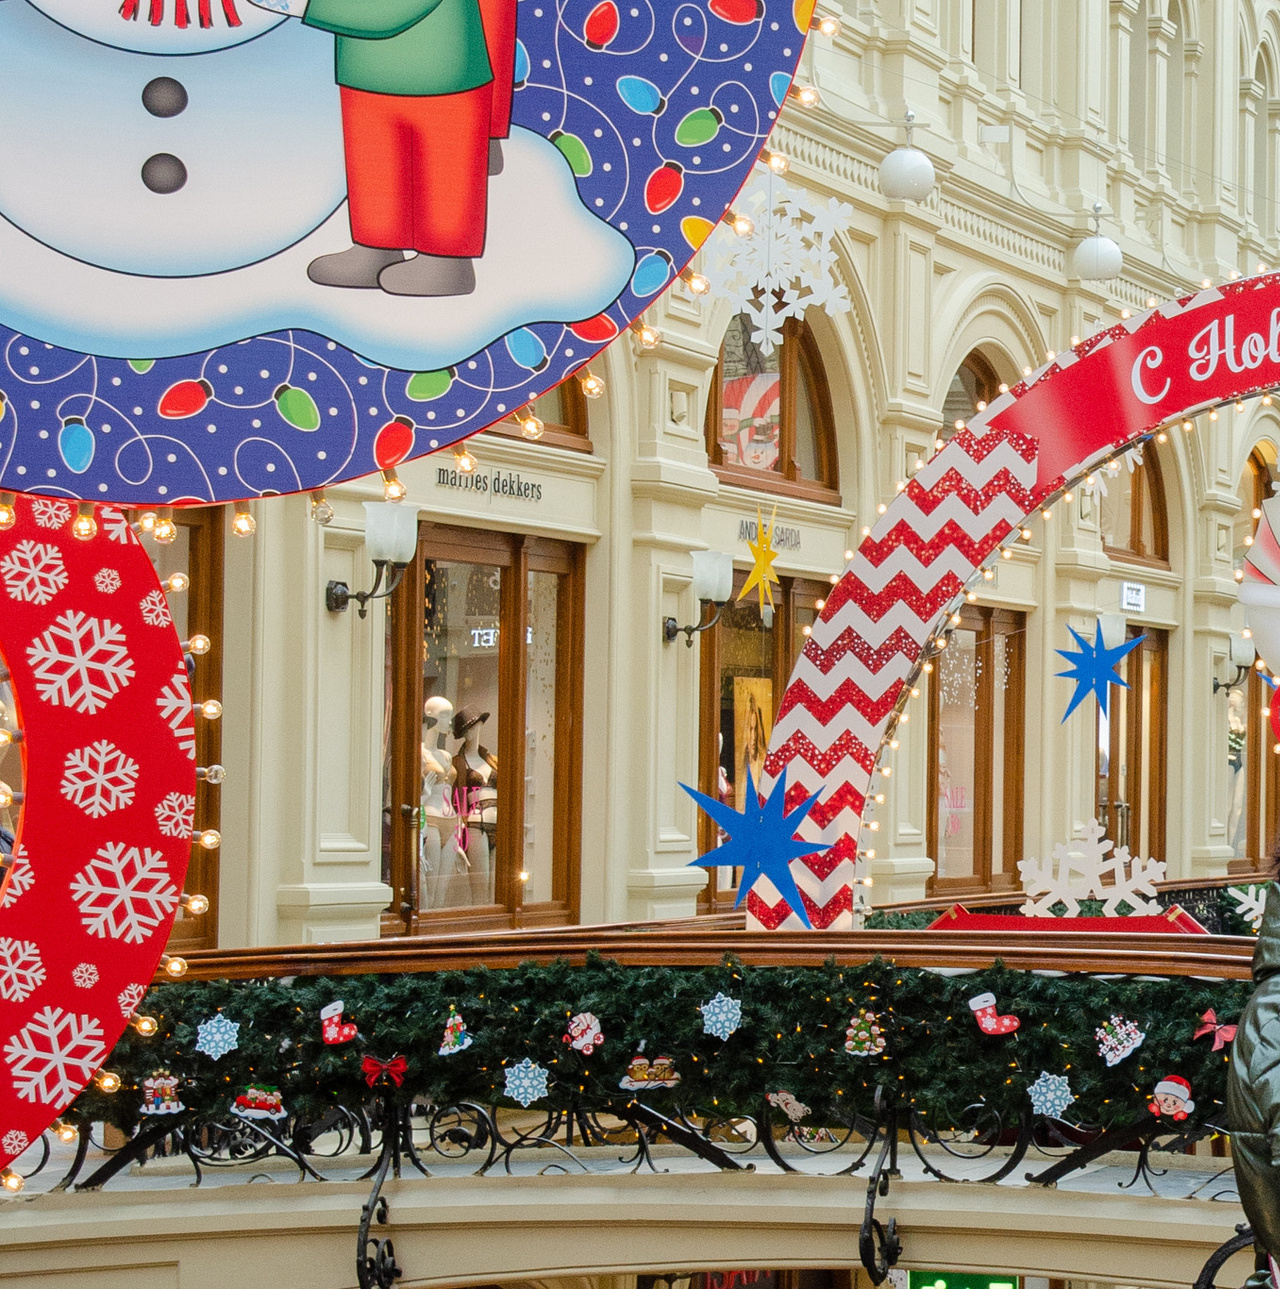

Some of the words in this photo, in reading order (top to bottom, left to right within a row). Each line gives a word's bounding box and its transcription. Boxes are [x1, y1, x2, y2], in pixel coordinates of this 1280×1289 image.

[1131, 346, 1171, 404] С
[493, 471, 542, 500] dekkers
[442, 786, 483, 817] SALE
